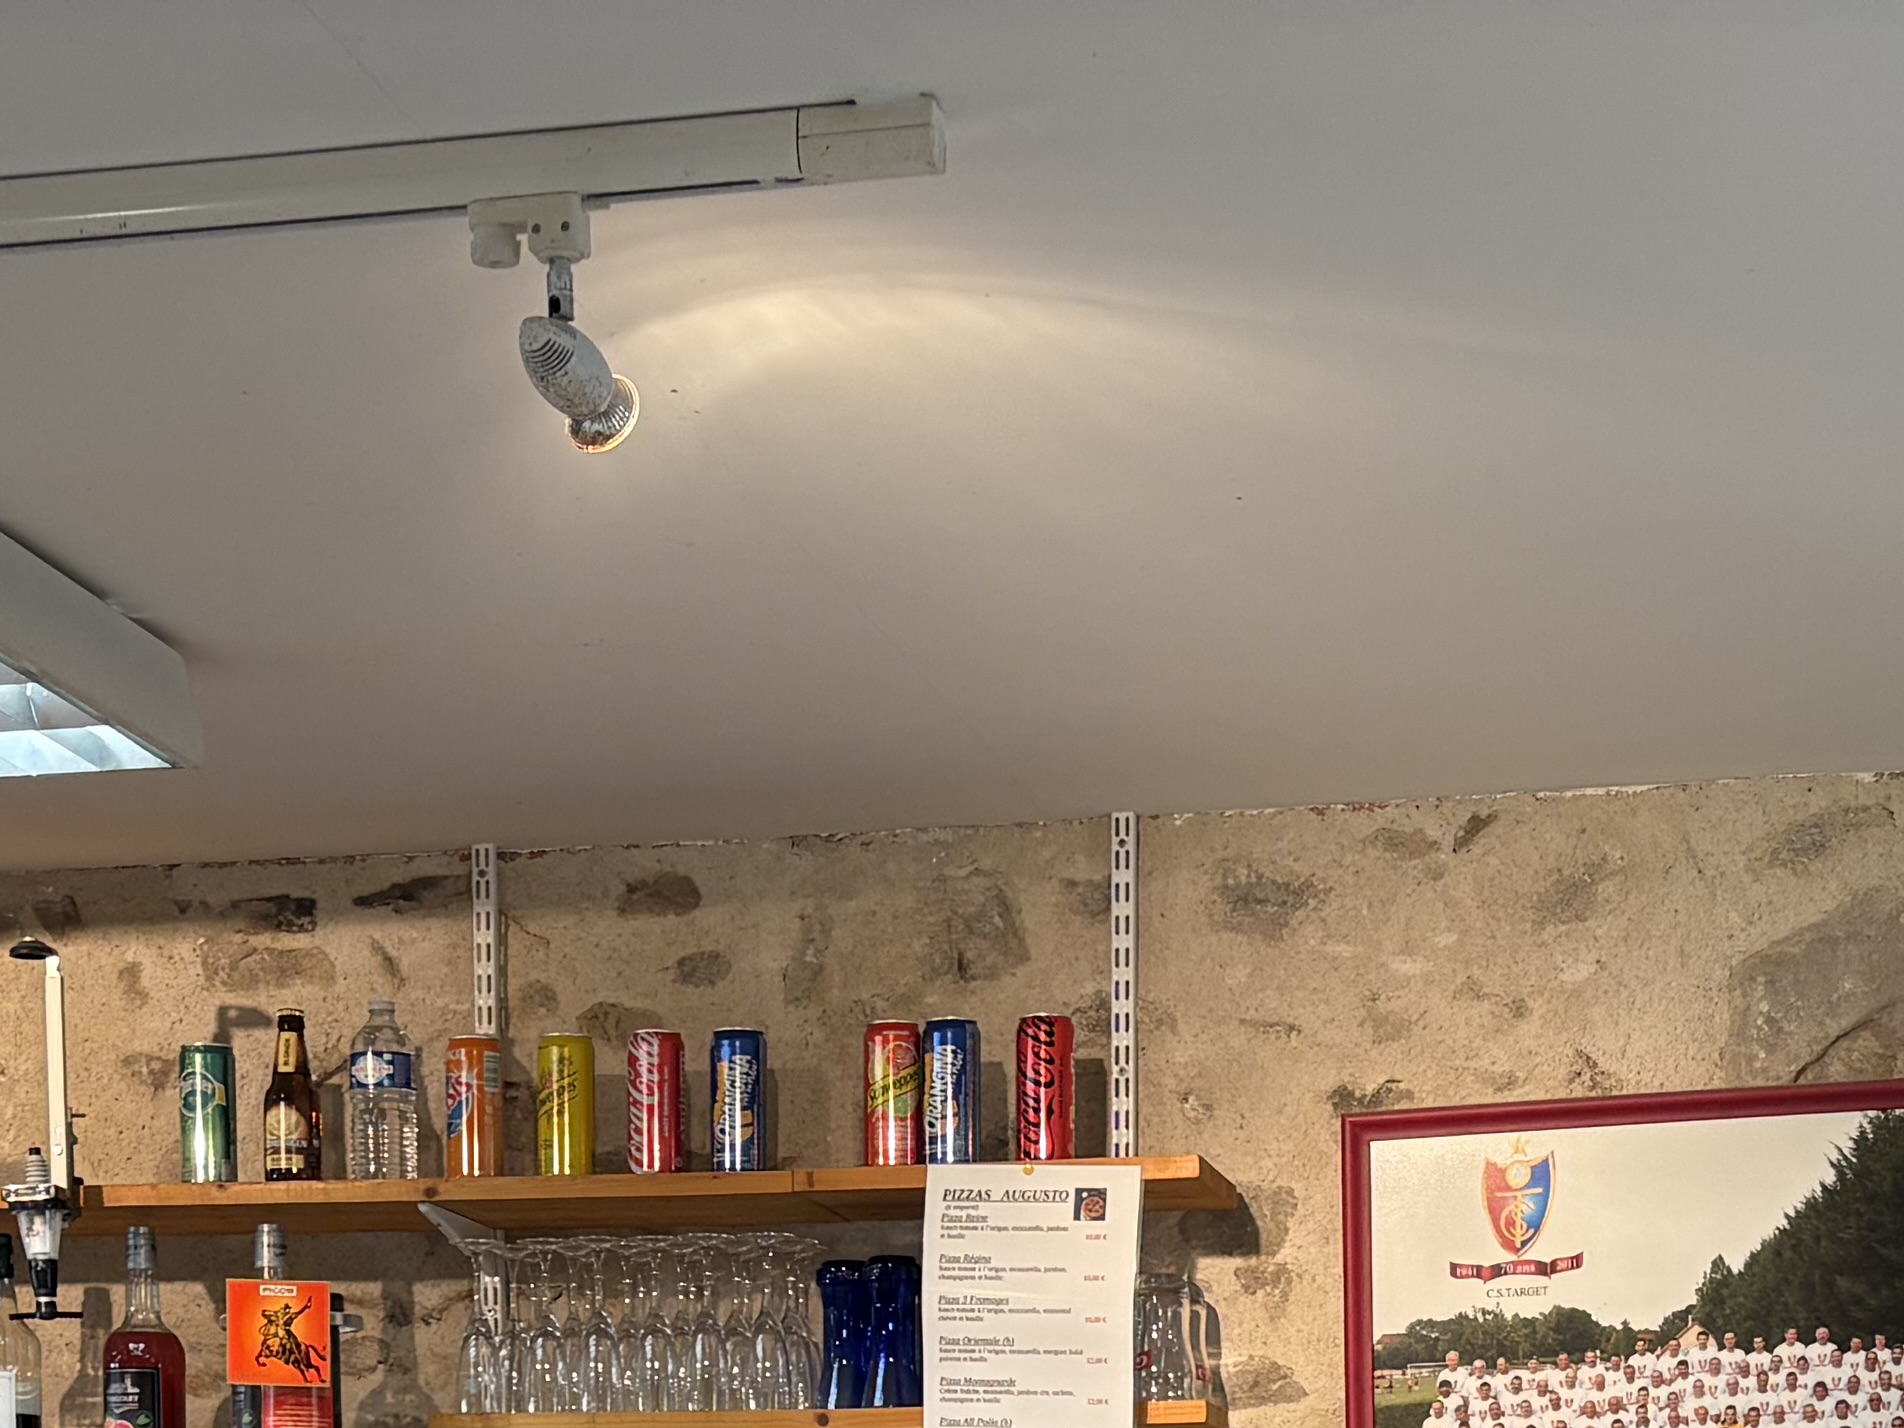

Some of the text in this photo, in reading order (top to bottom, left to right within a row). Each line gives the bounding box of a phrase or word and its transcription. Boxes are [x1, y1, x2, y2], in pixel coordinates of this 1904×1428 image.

[942, 1188, 1070, 1202] PIZZAS AUGUSTO
[939, 1253, 961, 1264] Pizza
[1500, 1263, 1514, 1274] 70
[939, 1336, 961, 1346] Pizza
[939, 1376, 962, 1386] Pizza
[939, 1417, 961, 1427] Pizza
